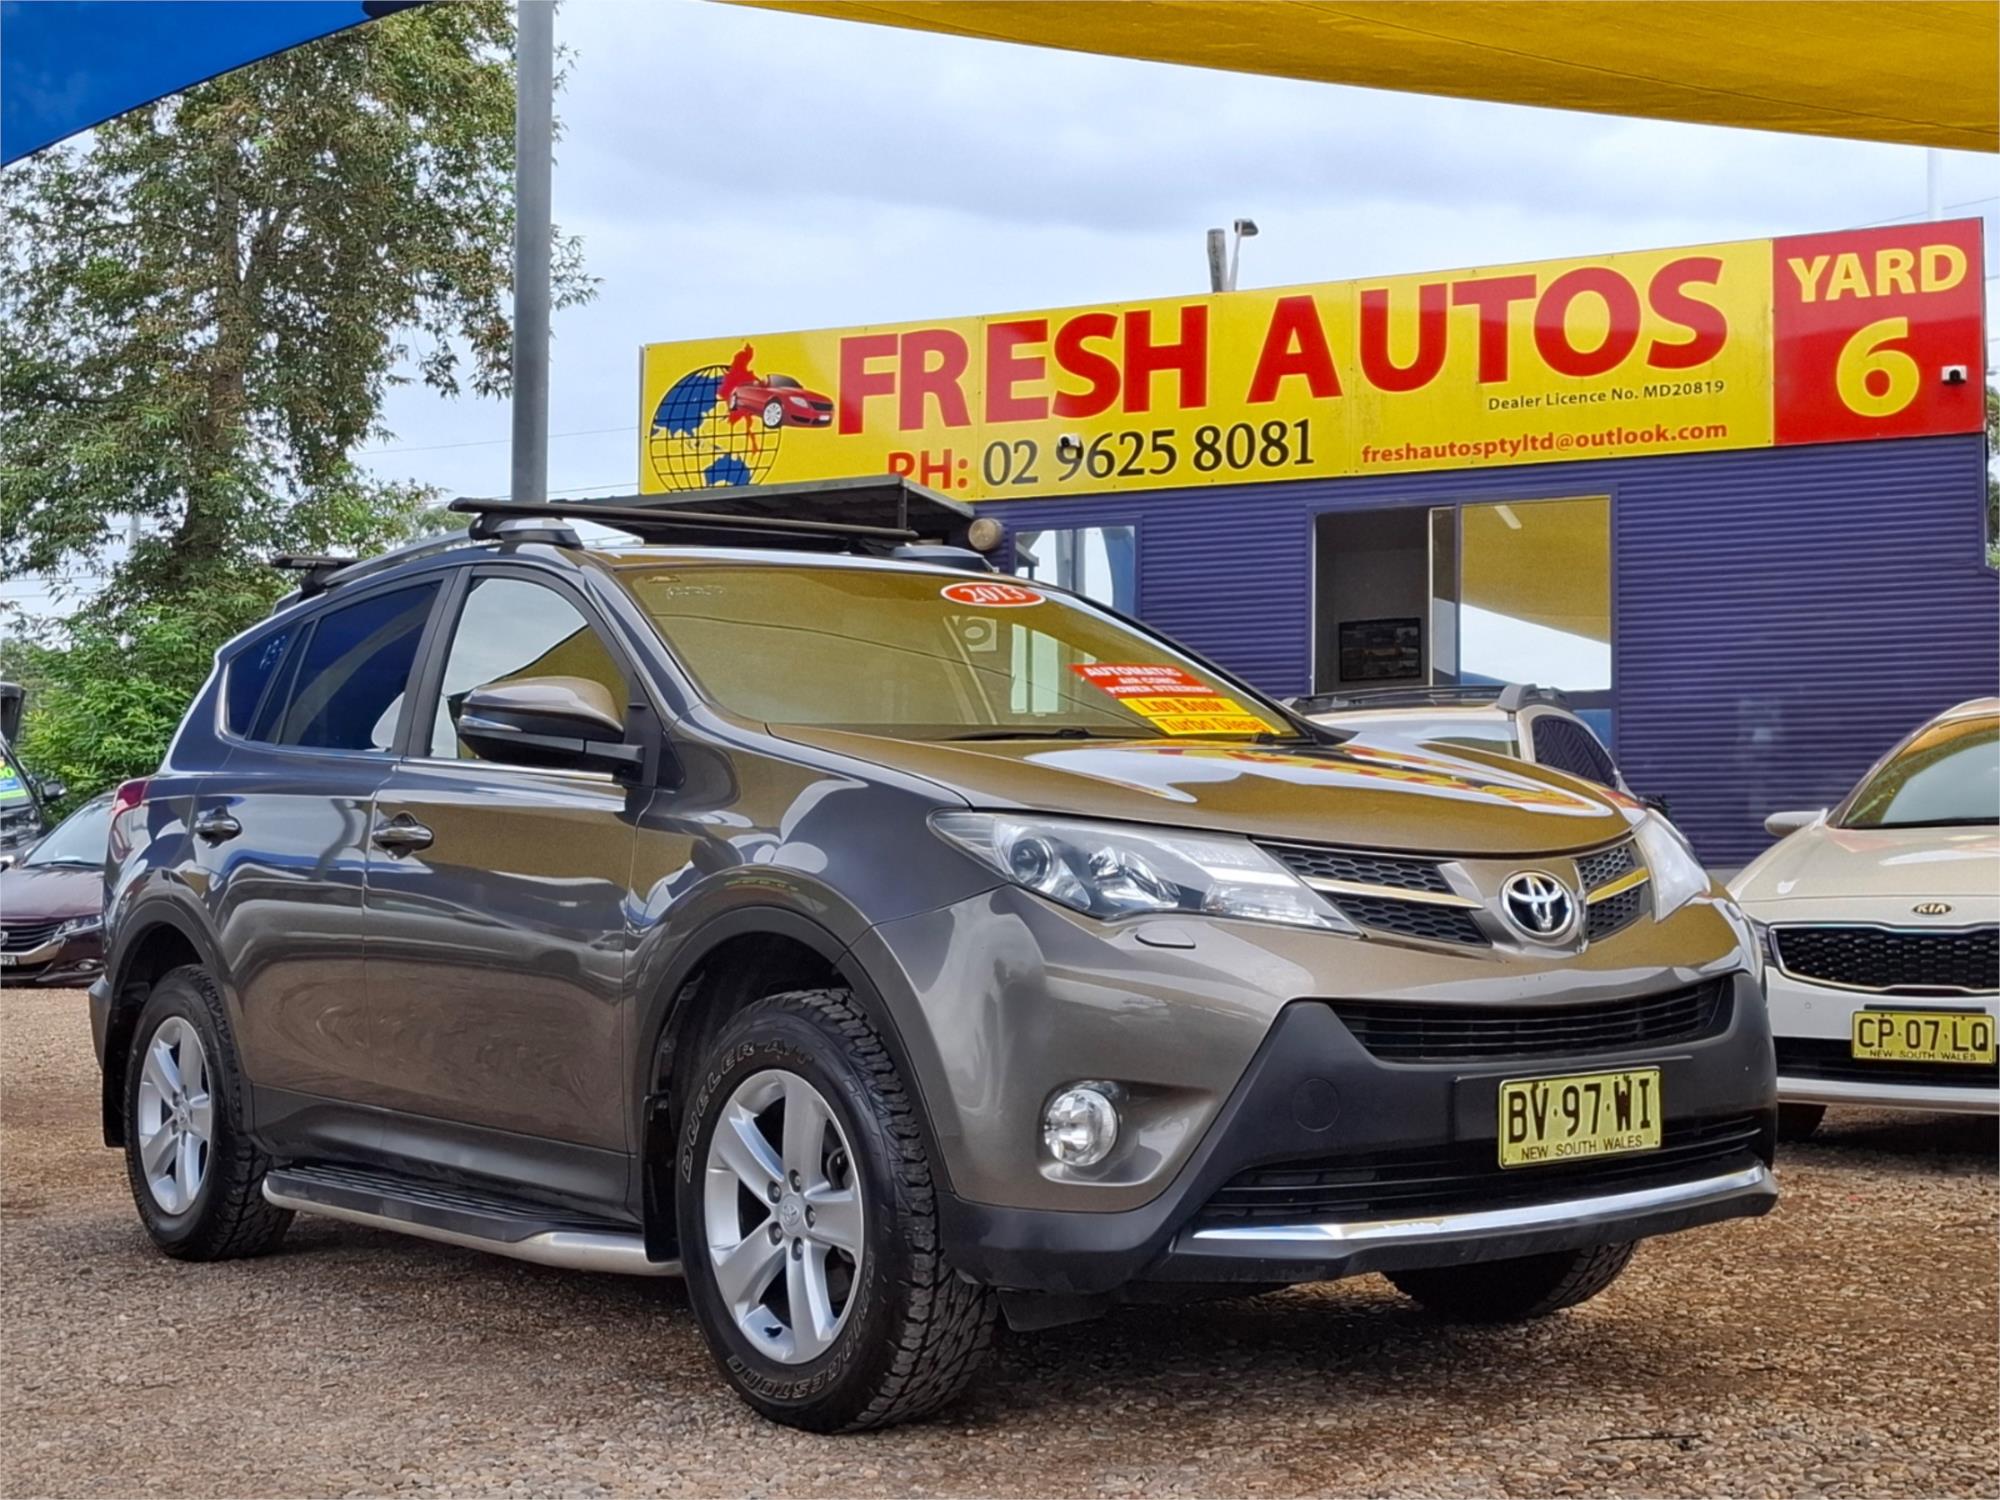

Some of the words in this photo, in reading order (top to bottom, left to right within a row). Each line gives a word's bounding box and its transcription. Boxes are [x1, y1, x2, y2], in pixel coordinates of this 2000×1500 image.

[1787, 244, 1968, 303] YARD
[838, 305, 1208, 436] FRESH
[1245, 256, 1728, 404] AUTOS
[1836, 316, 1920, 418] 6
[1488, 395, 1540, 411] Dealer
[1546, 389, 1606, 406] Licence
[1611, 387, 1639, 402] No.
[1643, 380, 1725, 399] MD20819
[887, 448, 968, 490] PH:
[983, 440, 1038, 487] 02
[1056, 429, 1178, 482] 9625
[1192, 420, 1315, 473] 8081
[1362, 423, 1728, 464] freshautosptyltd@outlook.com
[1083, 666, 1183, 677] AUTOMATIC
[1917, 904, 1946, 913] KIA
[1870, 1050, 1893, 1058] NEW
[1900, 1051, 1936, 1060] SOUTH
[1942, 1053, 1977, 1061] WALES
[1520, 1147, 1549, 1161] NEW
[1556, 1140, 1597, 1157] SOUTH
[1603, 1134, 1643, 1151] WALES
